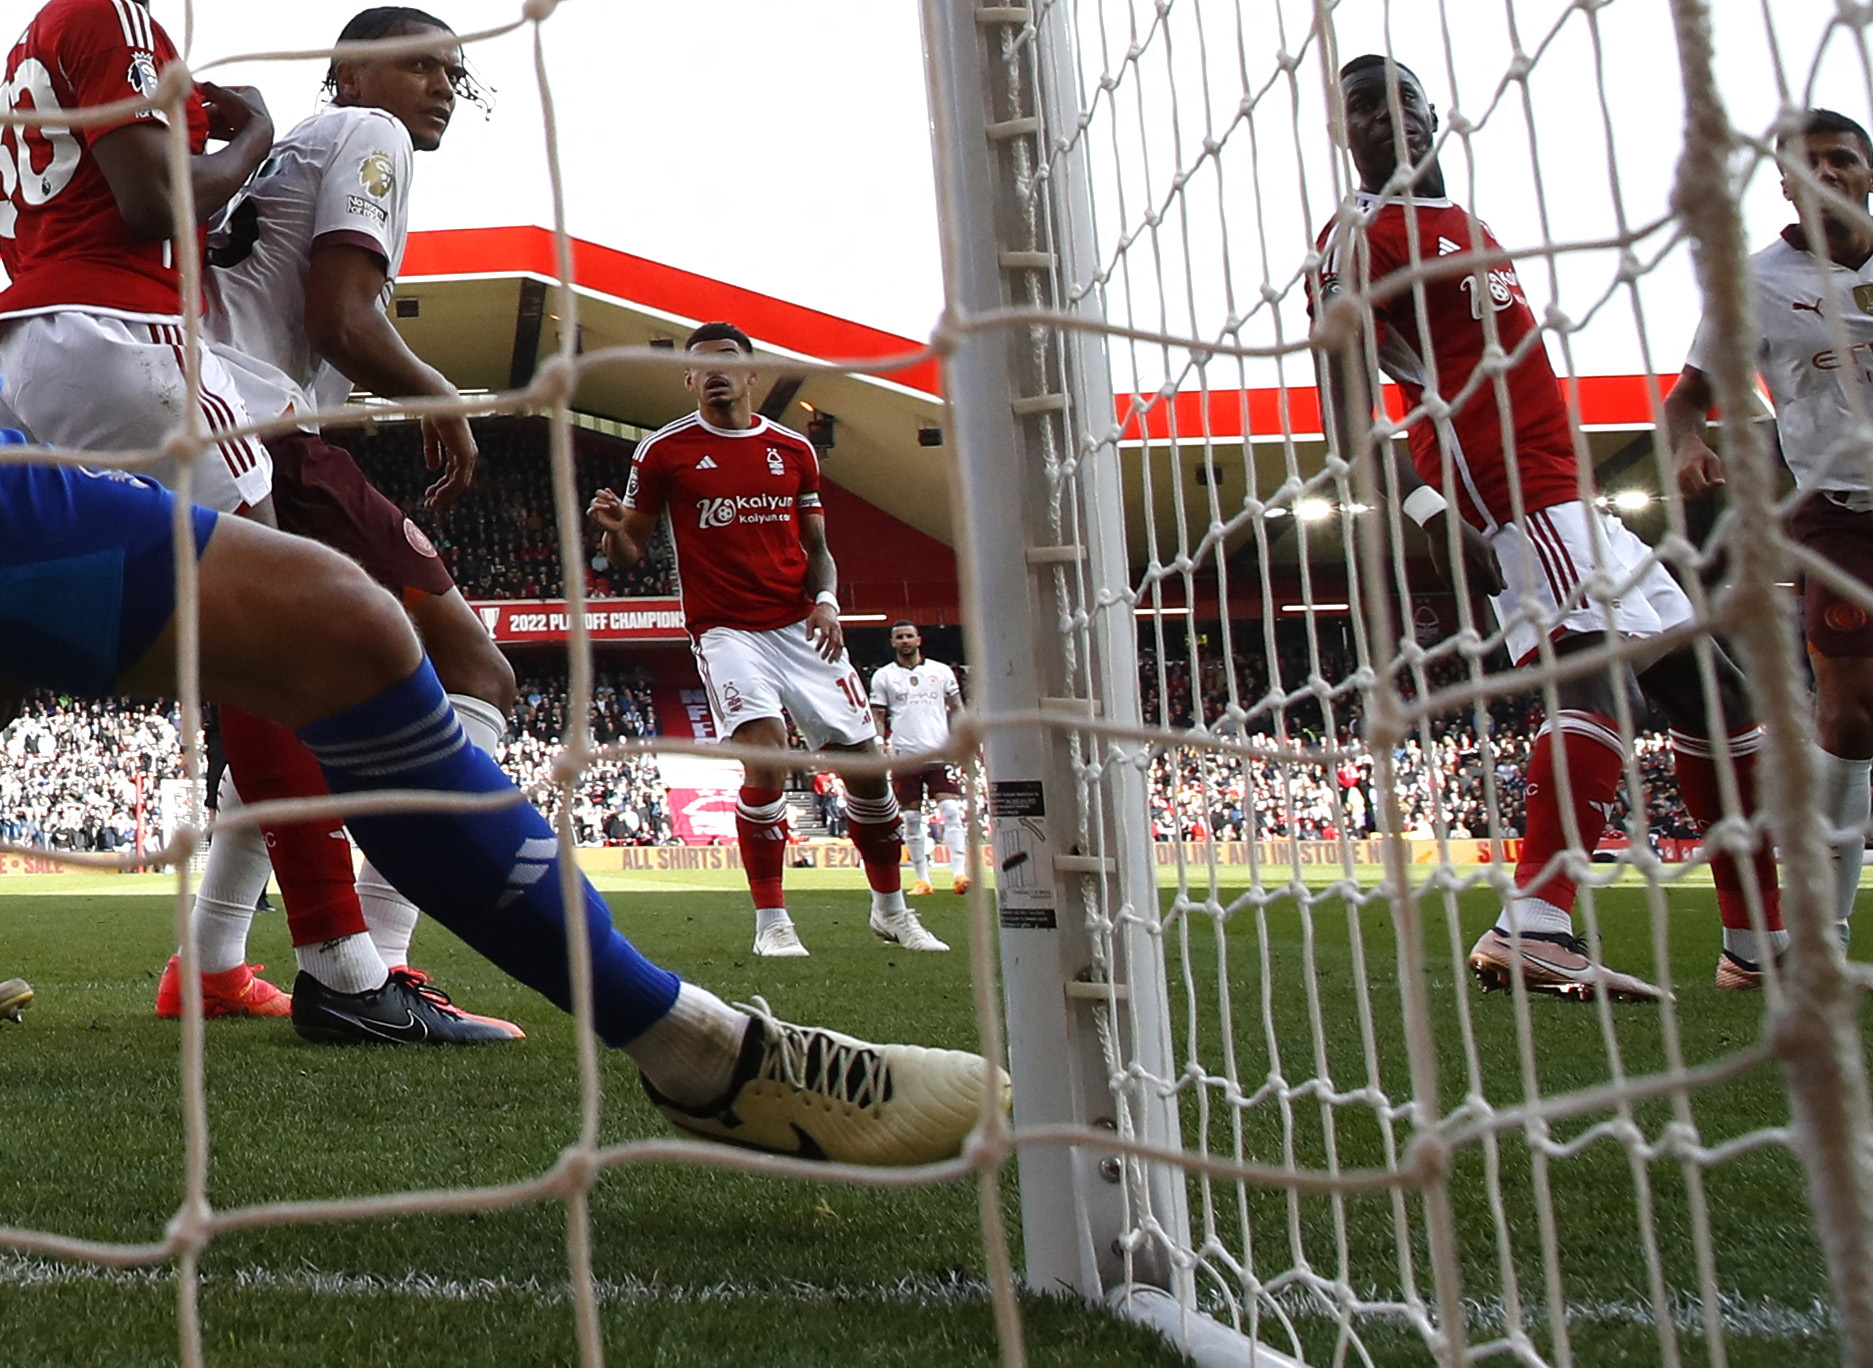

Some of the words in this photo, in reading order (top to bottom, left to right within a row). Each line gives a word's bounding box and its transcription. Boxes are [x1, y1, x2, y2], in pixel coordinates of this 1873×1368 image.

[509, 613, 547, 631] 2022
[610, 610, 686, 630] CHAMPIONS
[836, 671, 866, 713] 10
[622, 847, 653, 870] ALL
[656, 847, 722, 870] SHIRTS
